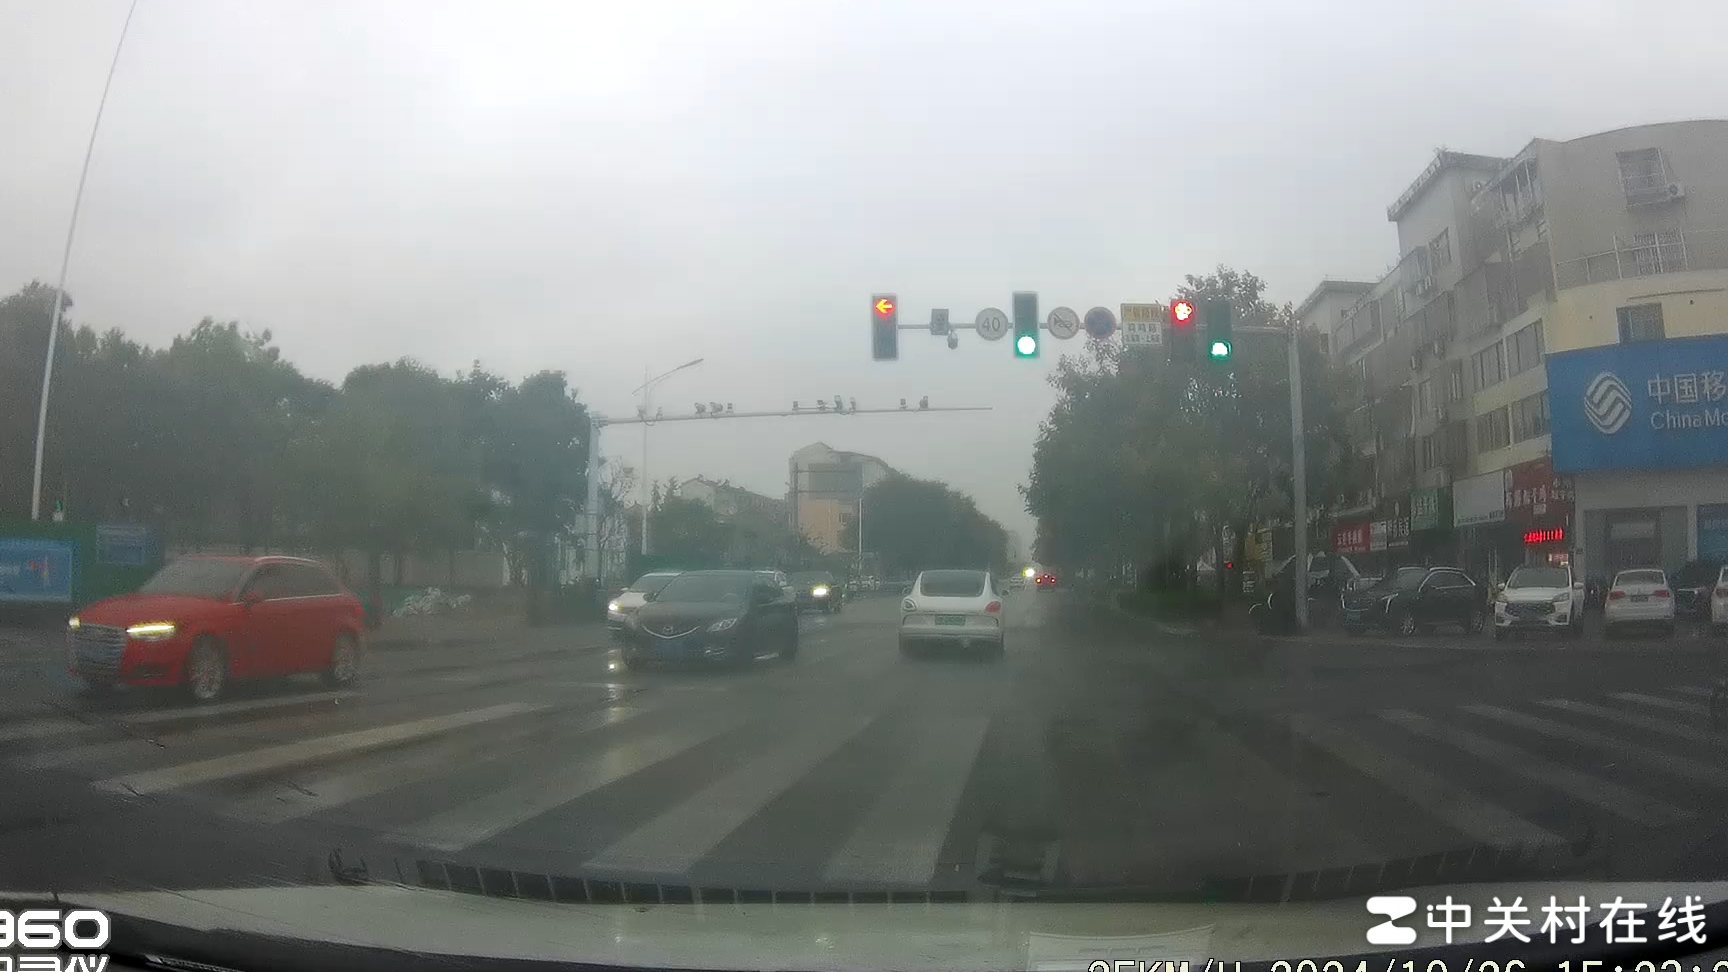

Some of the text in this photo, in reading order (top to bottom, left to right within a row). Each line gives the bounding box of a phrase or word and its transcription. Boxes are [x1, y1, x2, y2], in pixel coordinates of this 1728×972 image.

[982, 317, 1001, 332] 40
[1647, 370, 1727, 405] 中国移
[1650, 409, 1702, 430] China
